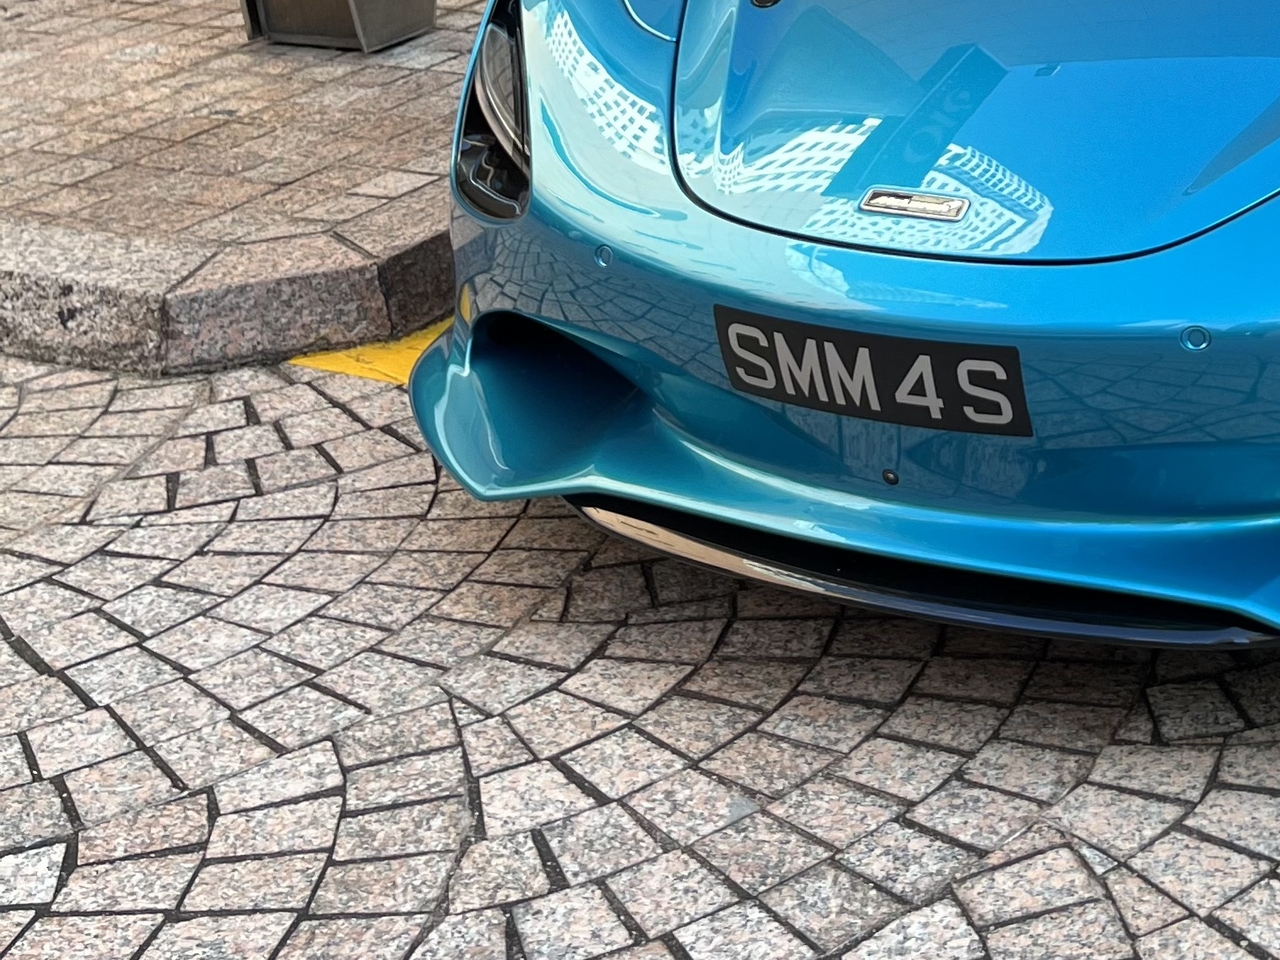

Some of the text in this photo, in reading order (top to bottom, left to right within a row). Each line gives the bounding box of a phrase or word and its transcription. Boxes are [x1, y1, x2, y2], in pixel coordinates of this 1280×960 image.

[727, 323, 1013, 424] SMM 4 S
